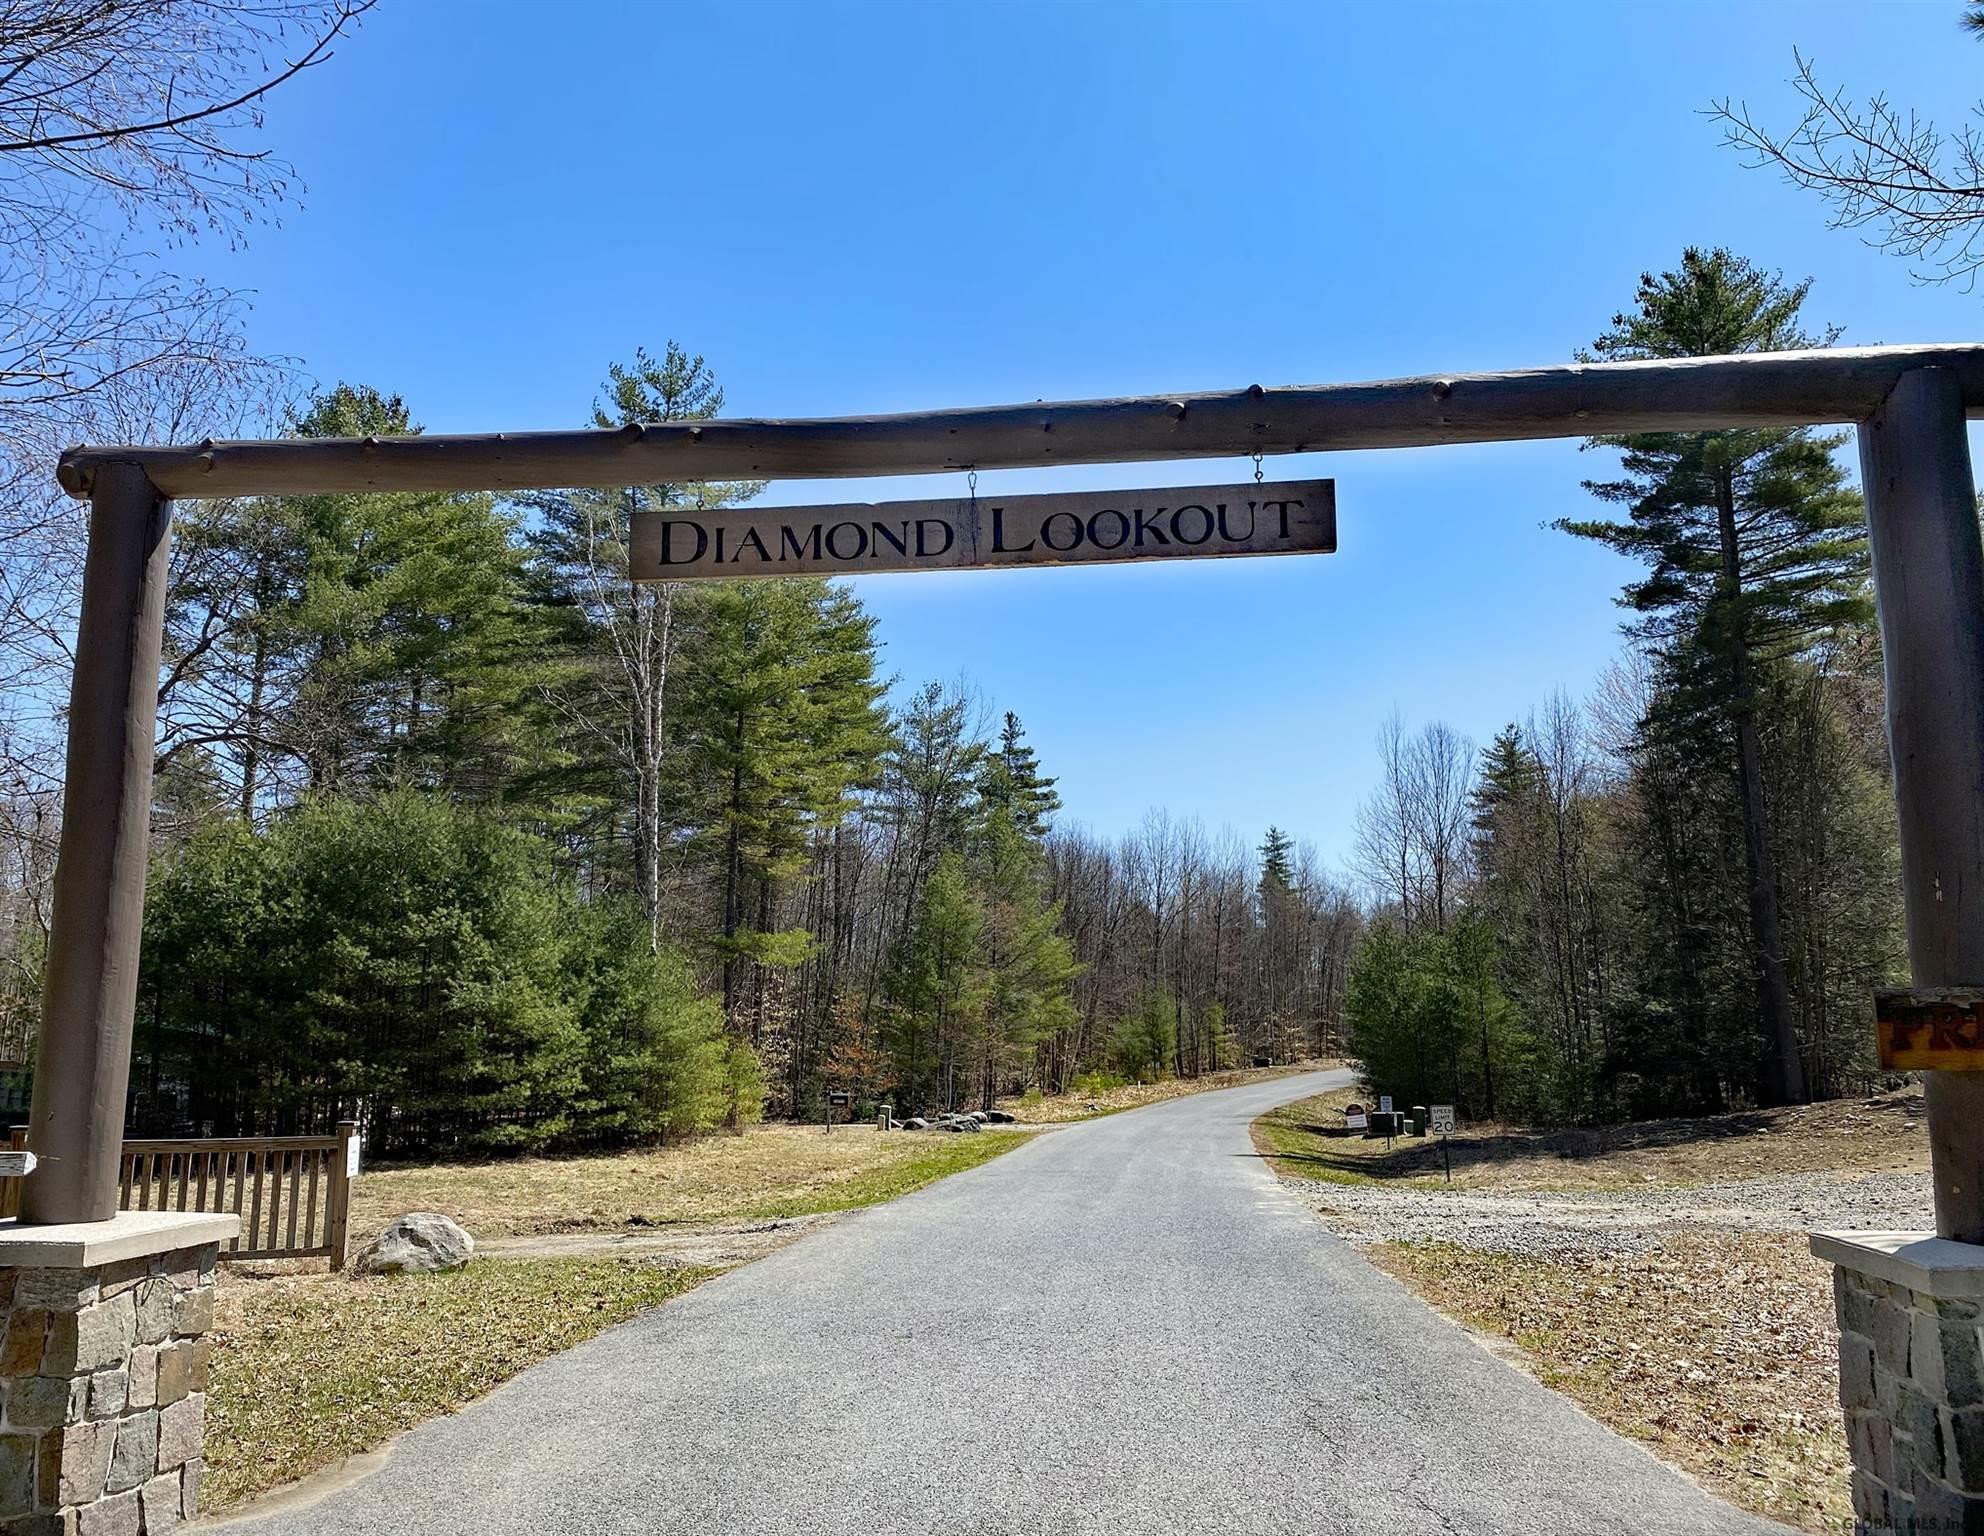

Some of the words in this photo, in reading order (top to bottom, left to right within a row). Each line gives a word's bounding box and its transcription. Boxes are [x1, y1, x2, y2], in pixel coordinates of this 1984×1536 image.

[659, 519, 954, 565] DIAMOND
[991, 499, 1306, 553] LOOKOUT
[1434, 1121, 1453, 1132] 20
